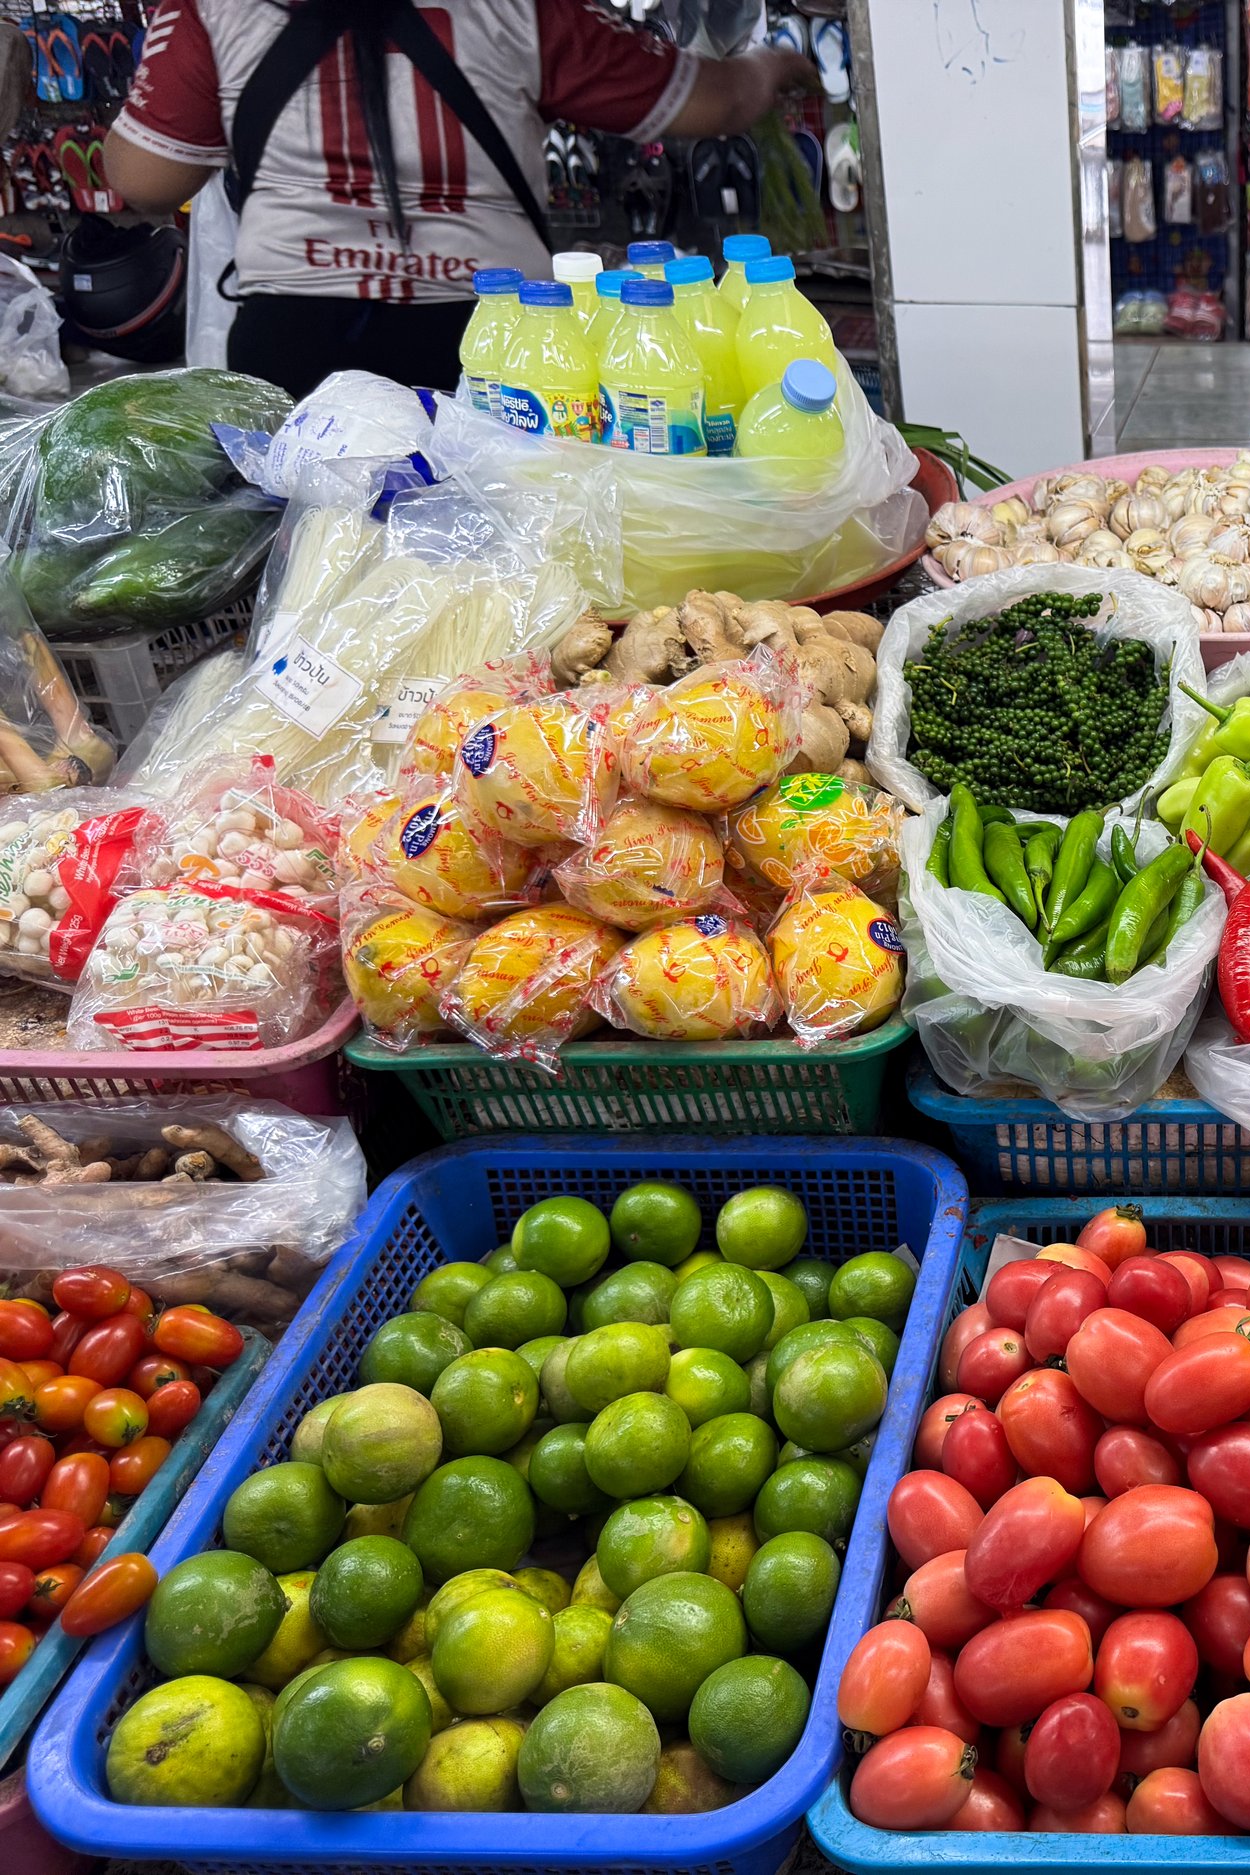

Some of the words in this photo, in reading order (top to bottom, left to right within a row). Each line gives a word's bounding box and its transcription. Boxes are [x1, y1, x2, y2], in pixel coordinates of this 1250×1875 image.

[304, 238, 479, 282] Emirates
[632, 717, 662, 737] Jing
[683, 711, 735, 724] Lemons
[408, 833, 427, 854] Pin
[623, 832, 654, 852] Jing
[74, 857, 89, 881] White
[236, 850, 277, 878] 555
[874, 931, 890, 941] Pin
[795, 956, 823, 985] Jing
[849, 976, 873, 997] Pin
